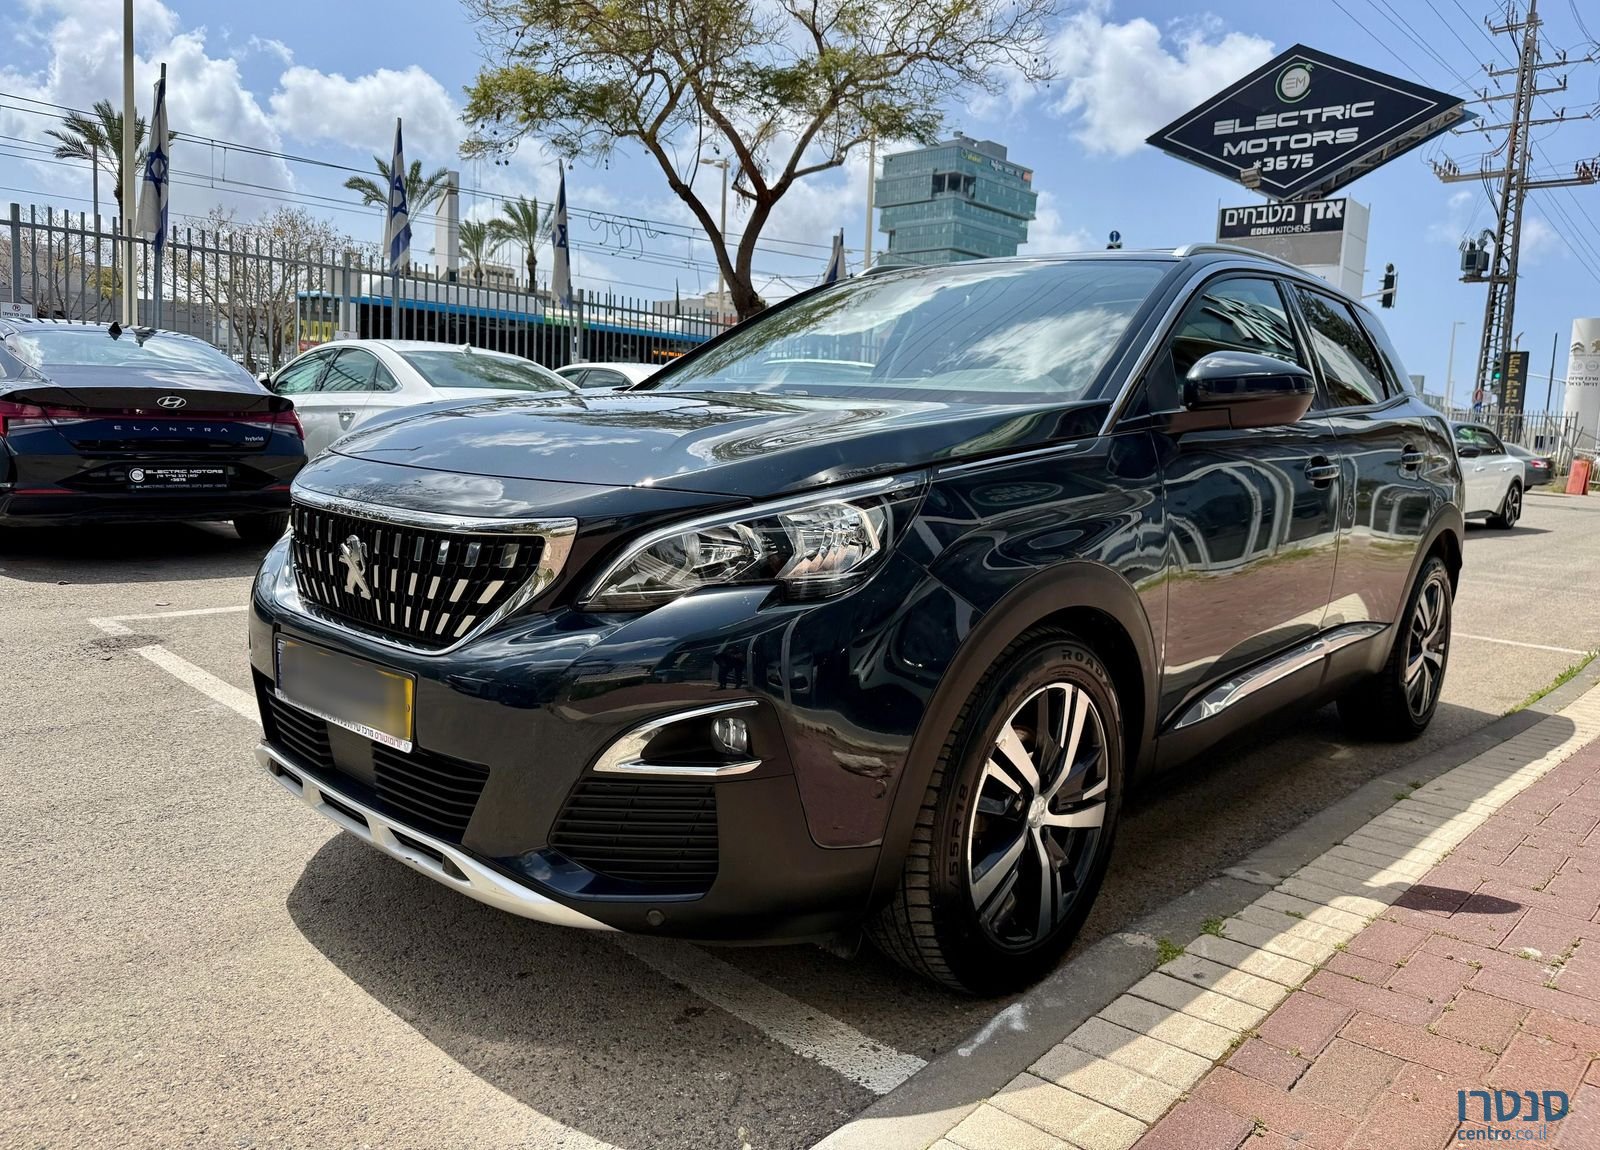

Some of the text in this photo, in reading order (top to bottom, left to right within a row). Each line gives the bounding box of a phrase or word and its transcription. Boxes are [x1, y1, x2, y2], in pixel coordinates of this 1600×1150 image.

[1285, 76, 1307, 91] EM
[1222, 127, 1359, 156] MOTORS
[1225, 200, 1344, 226] אדן מטבחים
[1250, 224, 1312, 236] EDEN KITCHENS
[114, 425, 229, 433] ELANTRA
[361, 725, 374, 737] מרכז
